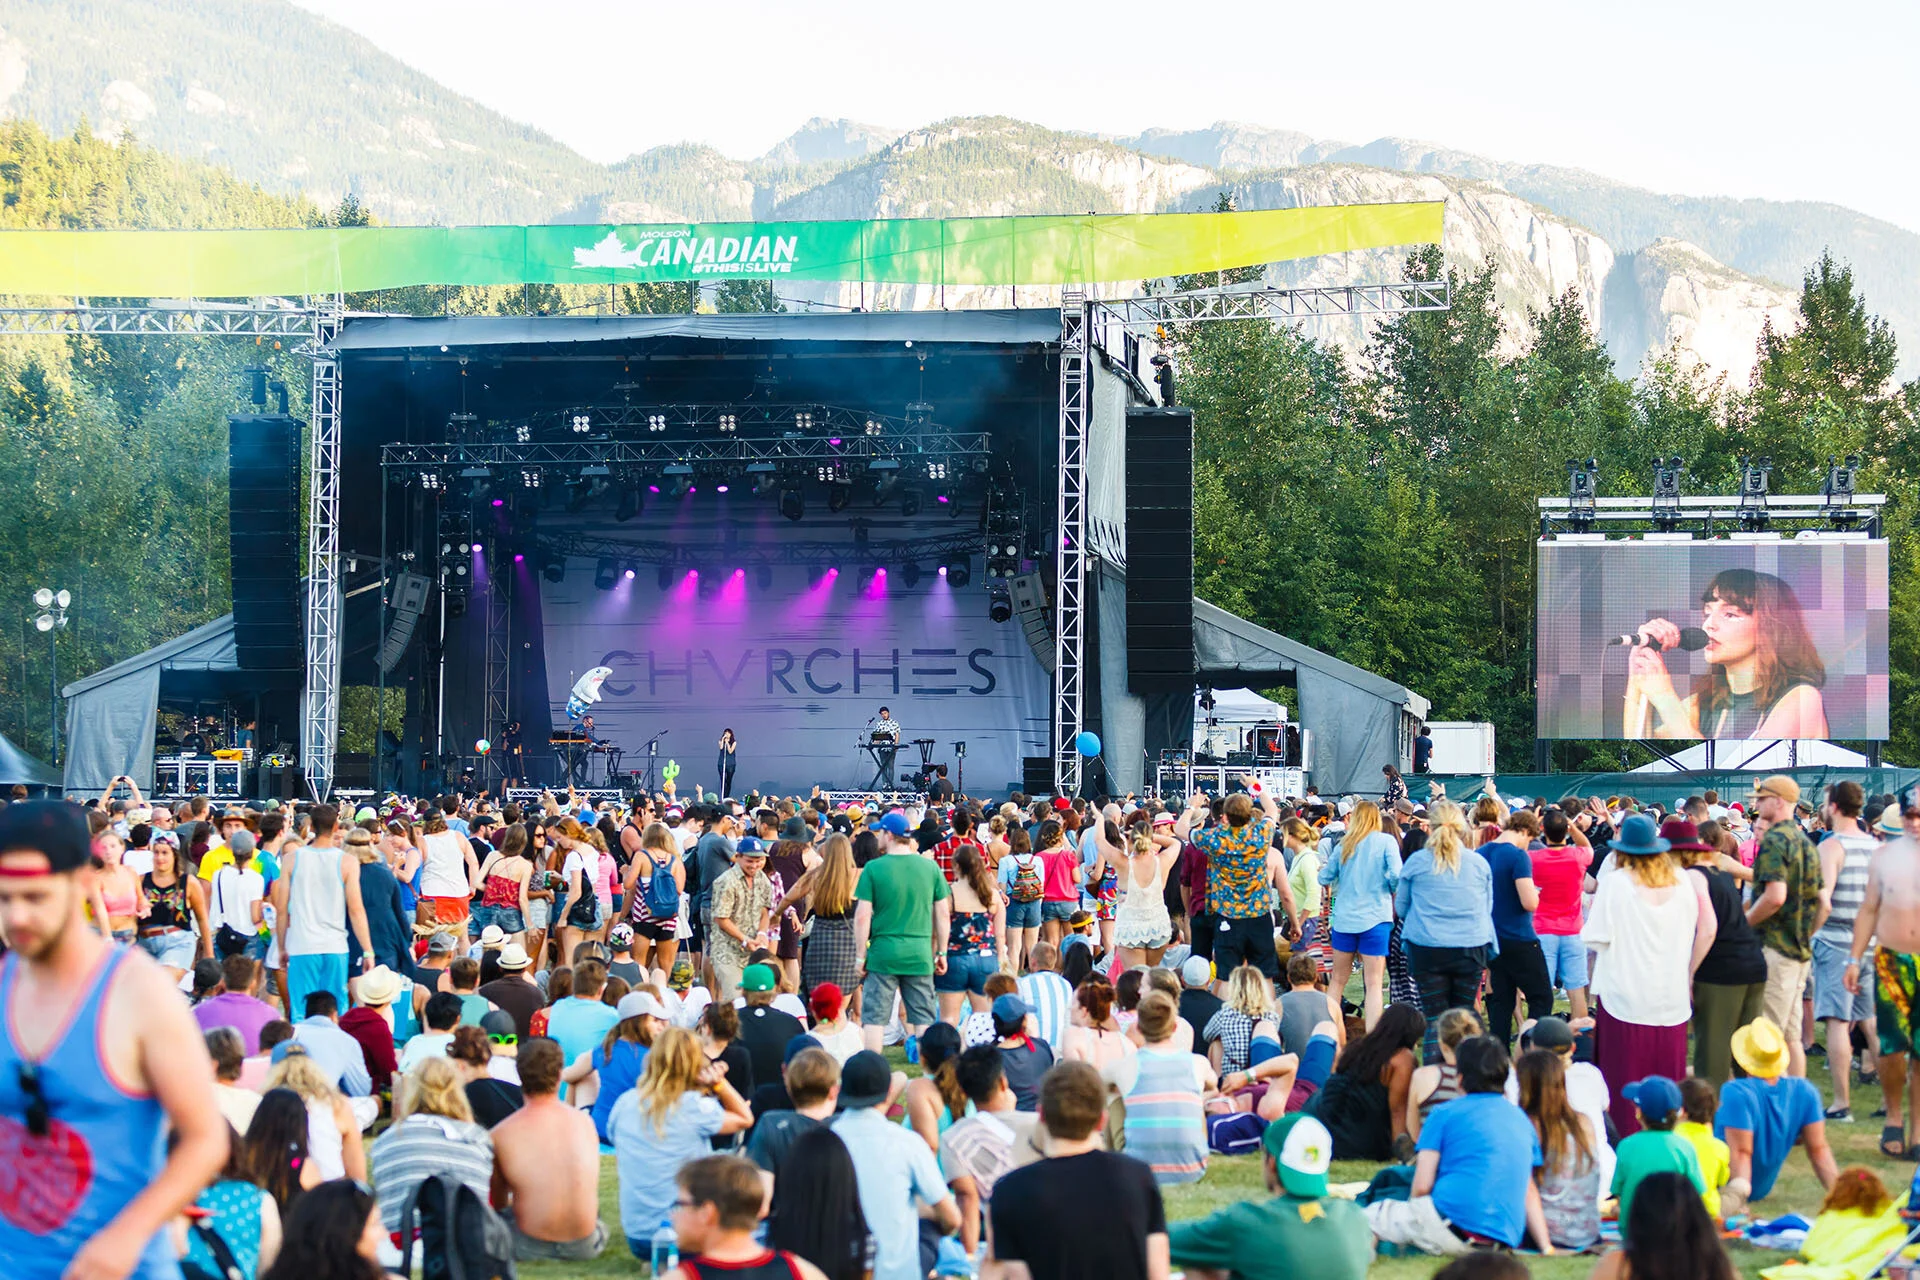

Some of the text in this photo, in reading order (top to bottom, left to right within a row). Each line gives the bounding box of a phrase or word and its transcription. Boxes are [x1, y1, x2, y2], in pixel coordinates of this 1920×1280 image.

[640, 230, 691, 239] MOLSON
[634, 235, 798, 267] CANADIAN
[692, 263, 793, 274] #THISISLIVE
[599, 647, 996, 696] CHVRCHES
